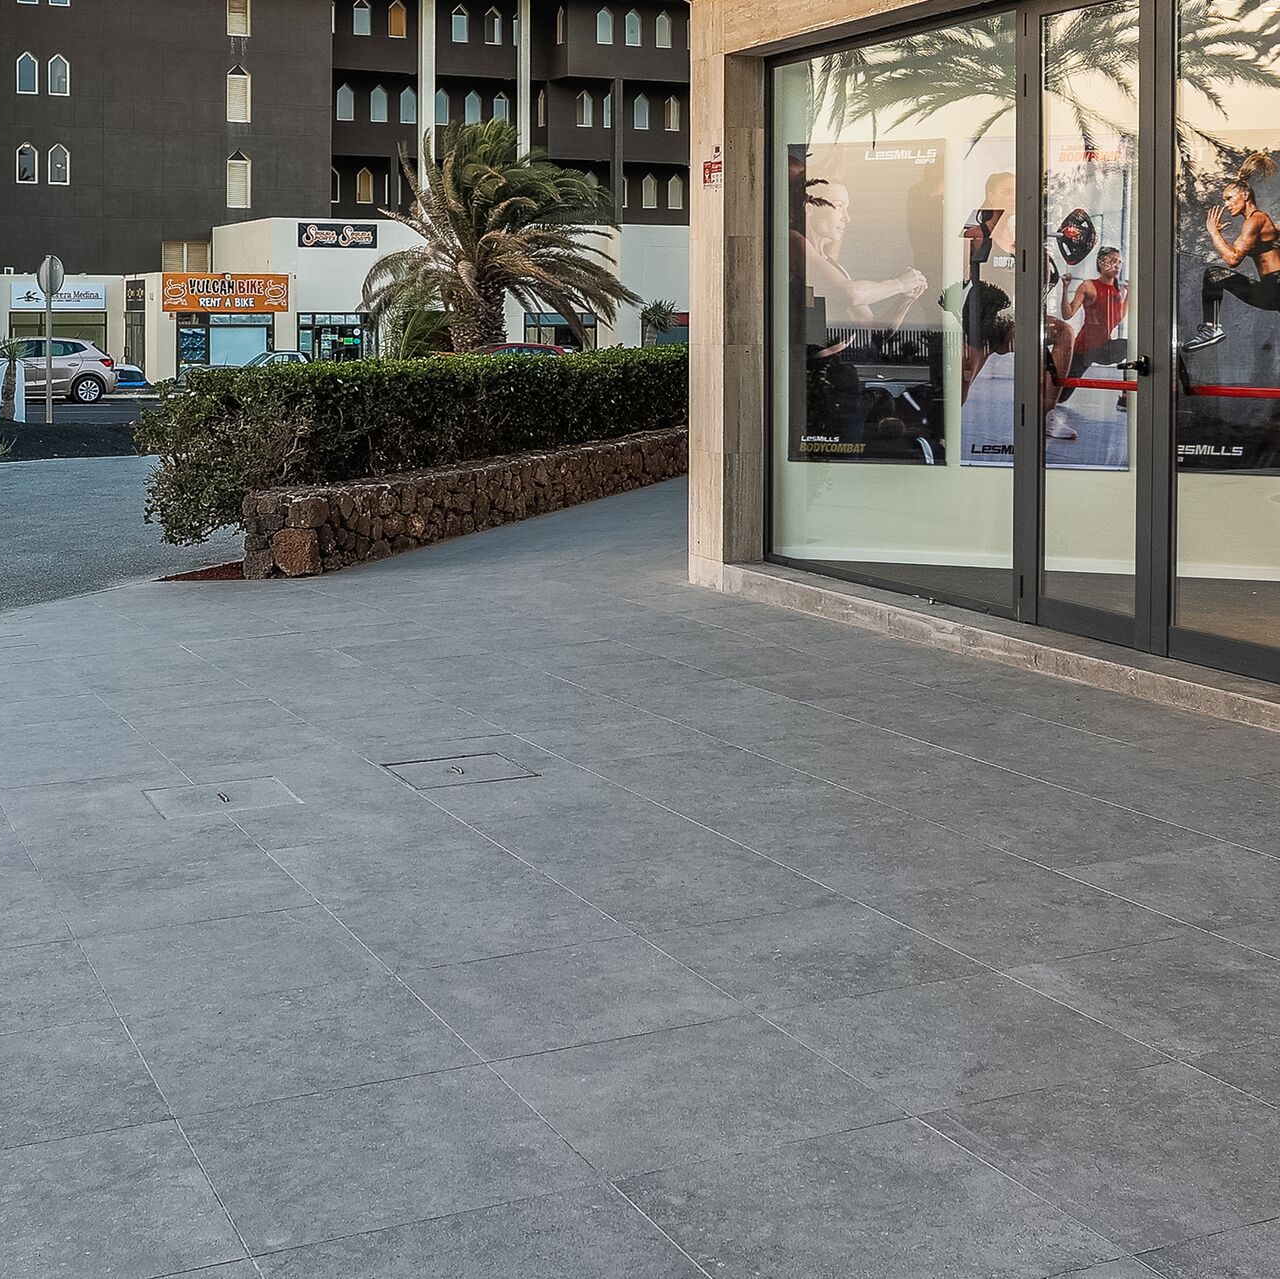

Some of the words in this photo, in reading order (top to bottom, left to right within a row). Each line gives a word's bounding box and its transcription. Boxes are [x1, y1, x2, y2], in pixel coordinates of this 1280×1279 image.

[188, 278, 236, 296] VULCAN
[237, 279, 265, 296] BIKE
[73, 290, 100, 300] Medina
[199, 297, 221, 308] RENT
[224, 298, 231, 308] A
[234, 298, 255, 308] BIKE
[799, 442, 866, 454] BODYCOMBAT
[970, 443, 1015, 455] LesM
[1177, 444, 1244, 457] esMILLS
